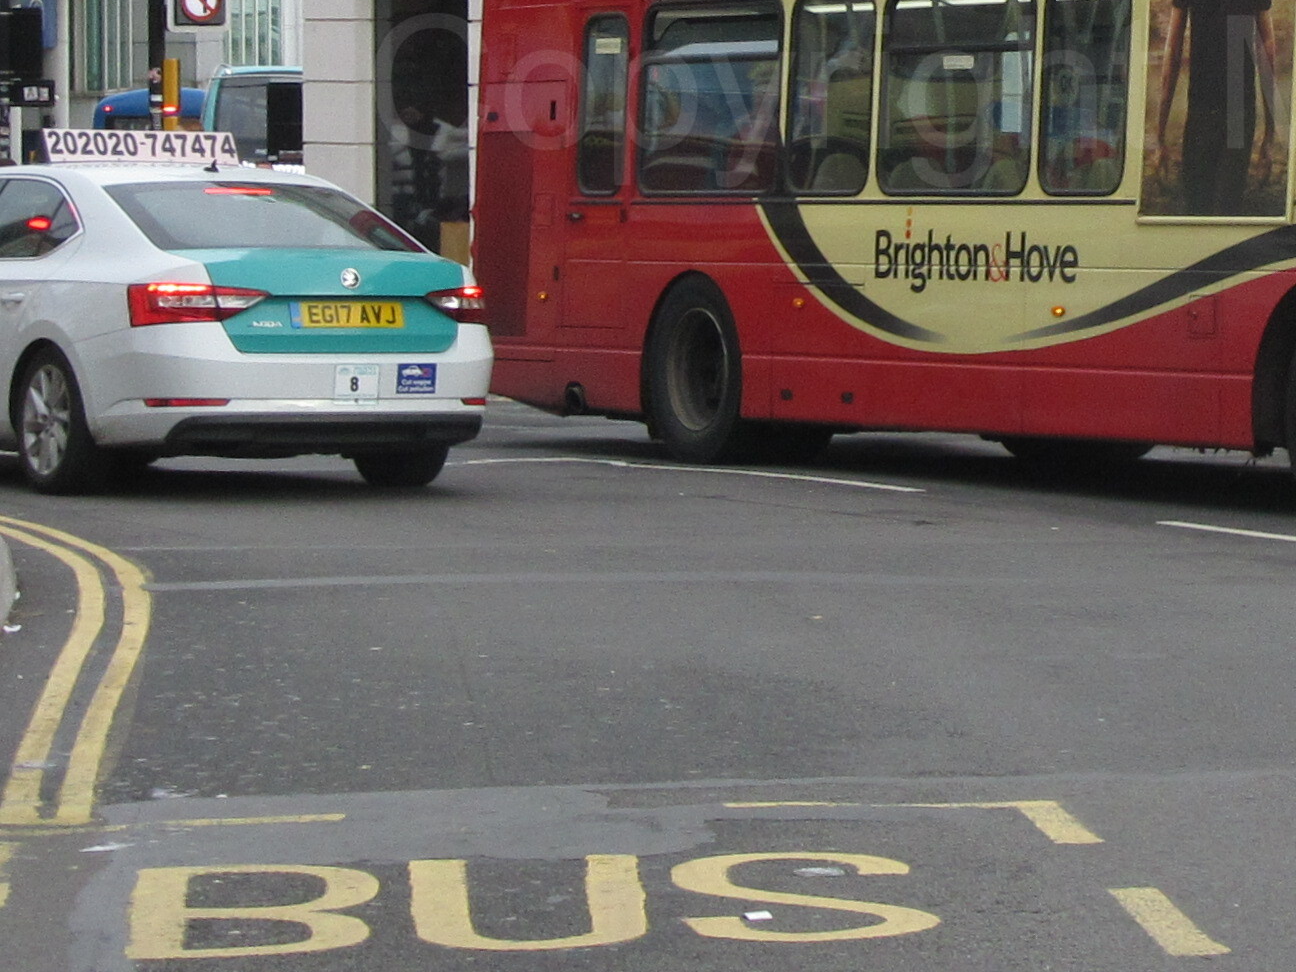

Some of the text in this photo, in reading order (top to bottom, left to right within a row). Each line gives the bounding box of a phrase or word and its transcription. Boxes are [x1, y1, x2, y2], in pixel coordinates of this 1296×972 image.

[49, 131, 236, 158] 202020-747474
[308, 305, 397, 324] EG17 AVJ
[350, 376, 359, 392] 8
[125, 852, 941, 959] BUS
